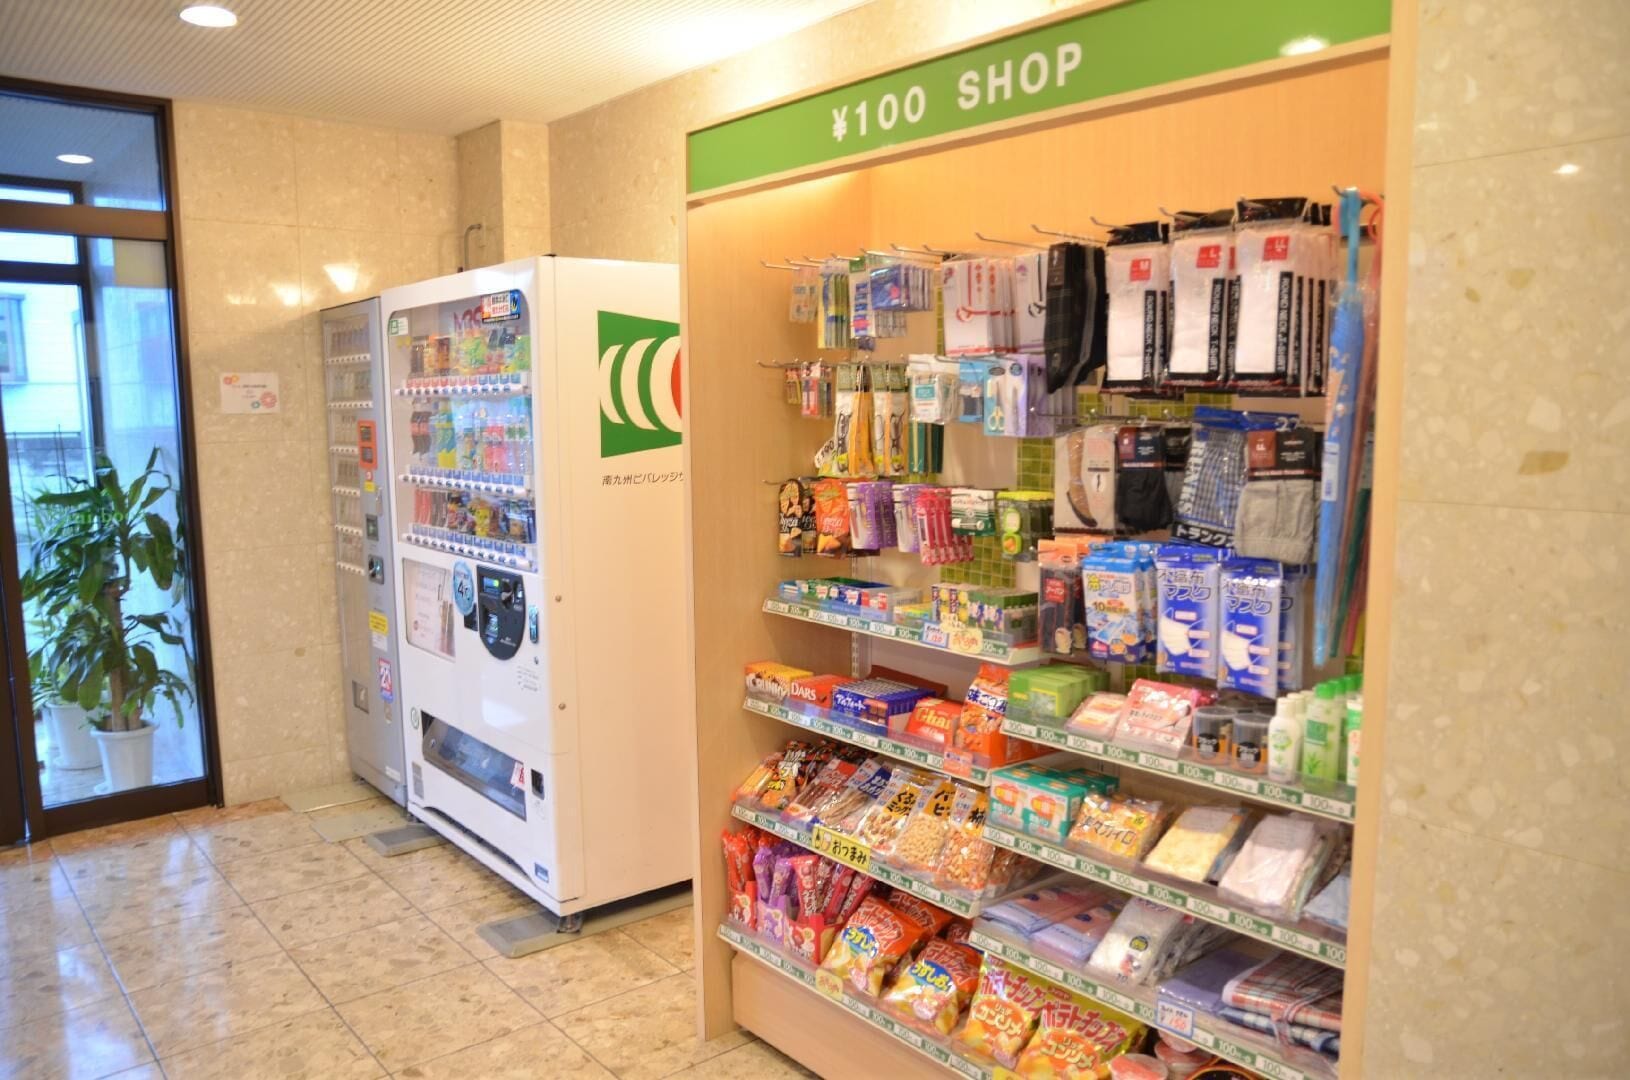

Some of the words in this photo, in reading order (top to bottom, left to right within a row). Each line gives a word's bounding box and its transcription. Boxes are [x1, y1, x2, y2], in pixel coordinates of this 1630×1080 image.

[832, 86, 926, 142] ¥100
[957, 42, 1082, 110] SHOP
[1164, 584, 1211, 602] マスク
[1224, 595, 1272, 617] マスク
[791, 682, 817, 701] DARS
[1184, 765, 1200, 778] 100
[1264, 784, 1282, 798] 100
[831, 841, 867, 866] おつまみ
[1153, 886, 1169, 899] 100
[1235, 915, 1253, 929] 100
[1280, 930, 1298, 945] 100
[1326, 946, 1345, 961] 100
[911, 961, 951, 991] うすしお
[1041, 1000, 1128, 1053] ポテトチップス
[1040, 1039, 1096, 1070] コンソメ
[1219, 1041, 1236, 1056] 100
[1264, 1059, 1281, 1075] 100
